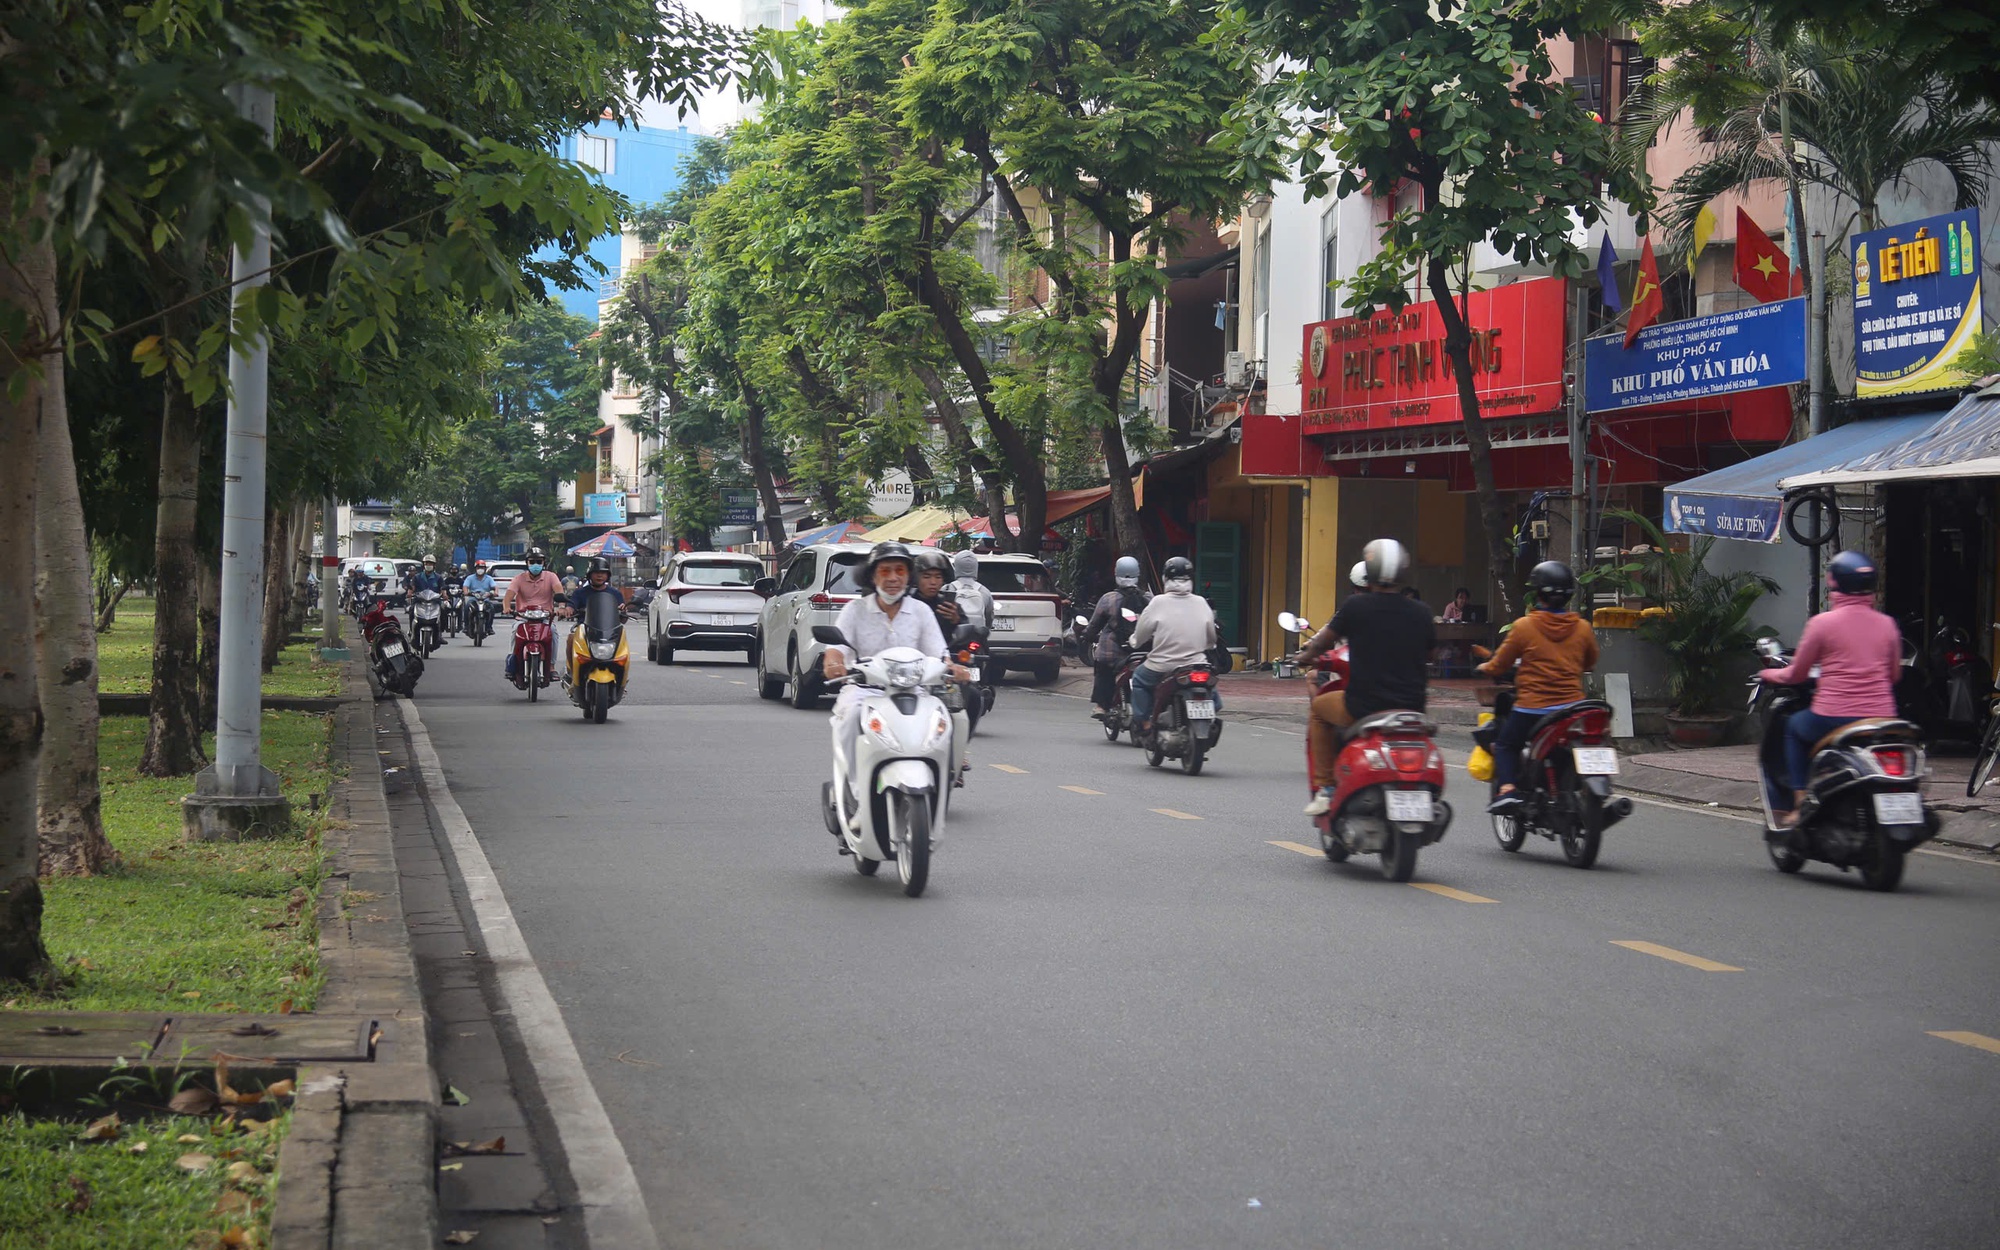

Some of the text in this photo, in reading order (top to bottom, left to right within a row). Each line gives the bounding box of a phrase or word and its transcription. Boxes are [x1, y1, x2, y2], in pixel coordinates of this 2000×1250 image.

[1879, 226, 1940, 283] LÊ TIẾN
[1856, 264, 1869, 278] TOP
[1709, 316, 1720, 325] XÂY
[1744, 308, 1758, 319] SỐNG
[1758, 306, 1770, 316] VĂN
[1886, 315, 1896, 330] CÁC
[1911, 312, 1918, 326] XE
[1928, 309, 1937, 322] GA
[1936, 306, 1944, 321] VÀ
[1944, 306, 1953, 320] XE
[1953, 302, 1962, 319] SỐ
[1726, 324, 1738, 335] MINH
[1657, 341, 1721, 362] KHU PHỐ 47
[1611, 350, 1771, 394] KHU PHỐ VĂN HÓA
[1681, 505, 1692, 514] TOP
[1696, 506, 1705, 515] OIL
[1716, 512, 1732, 530] SỬA
[1733, 516, 1744, 531] XE
[1745, 514, 1765, 533] TIẾN
